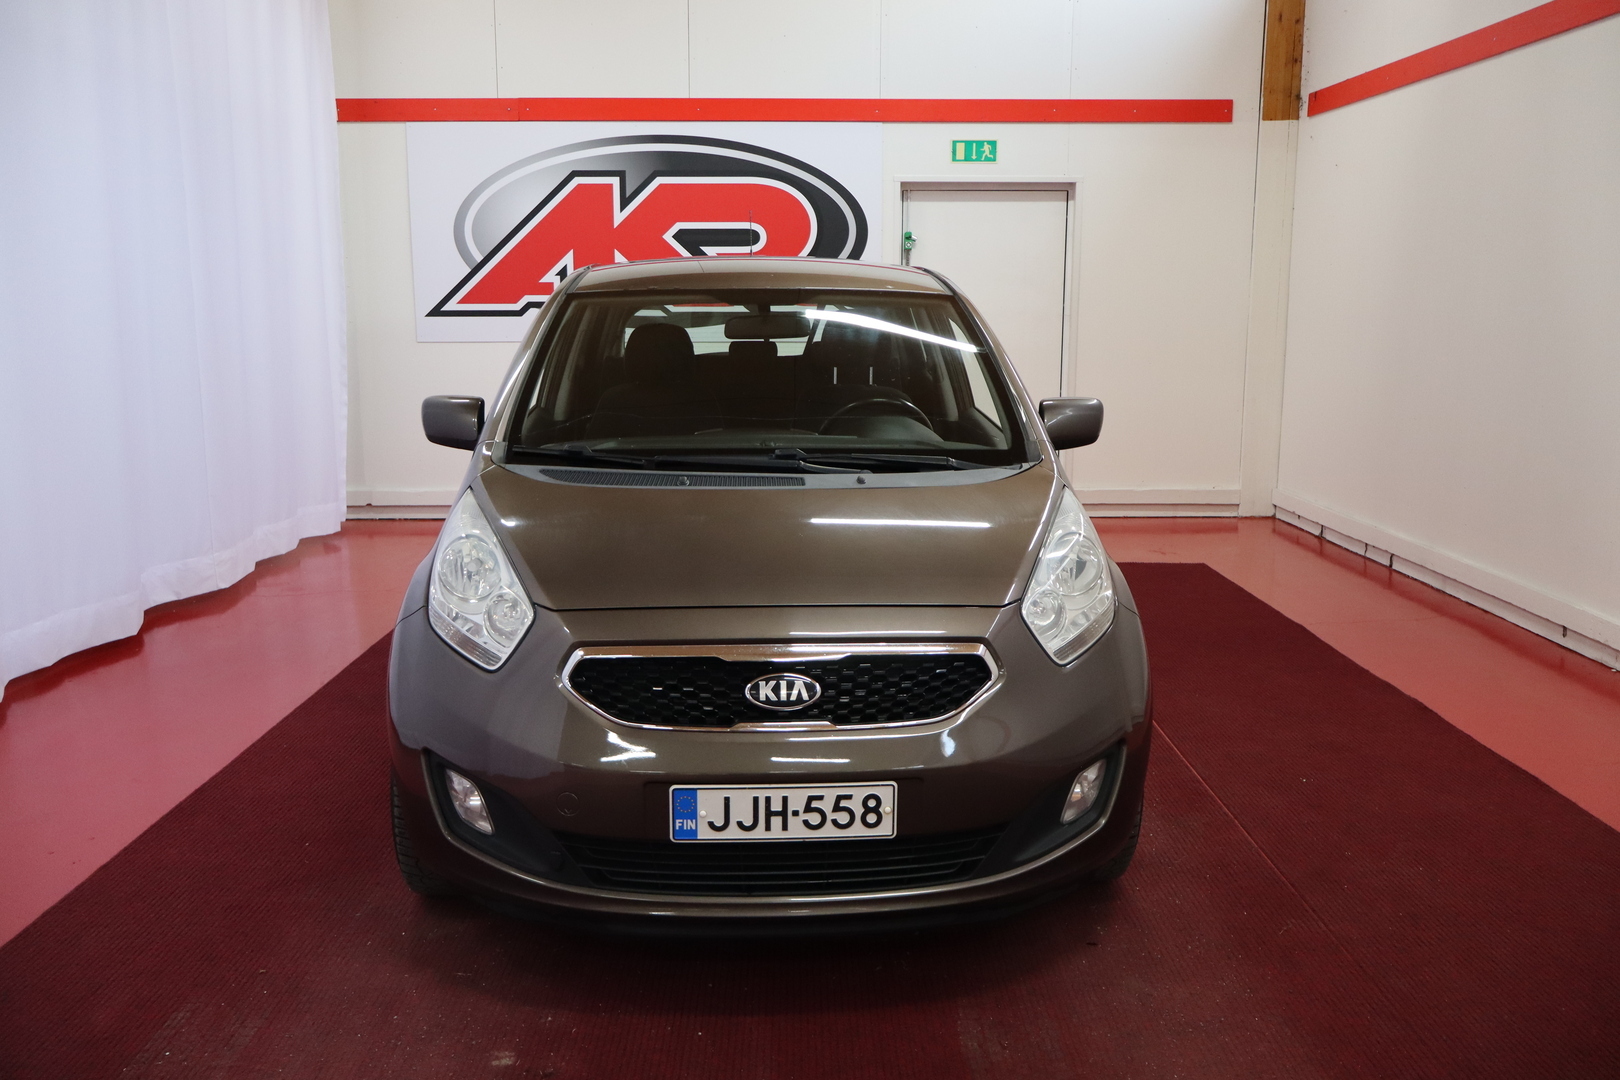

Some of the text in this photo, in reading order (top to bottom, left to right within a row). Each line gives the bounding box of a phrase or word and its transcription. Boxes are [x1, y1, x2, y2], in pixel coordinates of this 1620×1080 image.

[758, 680, 810, 701] KIA
[707, 793, 883, 832] JJH-558
[675, 819, 696, 830] FIN
